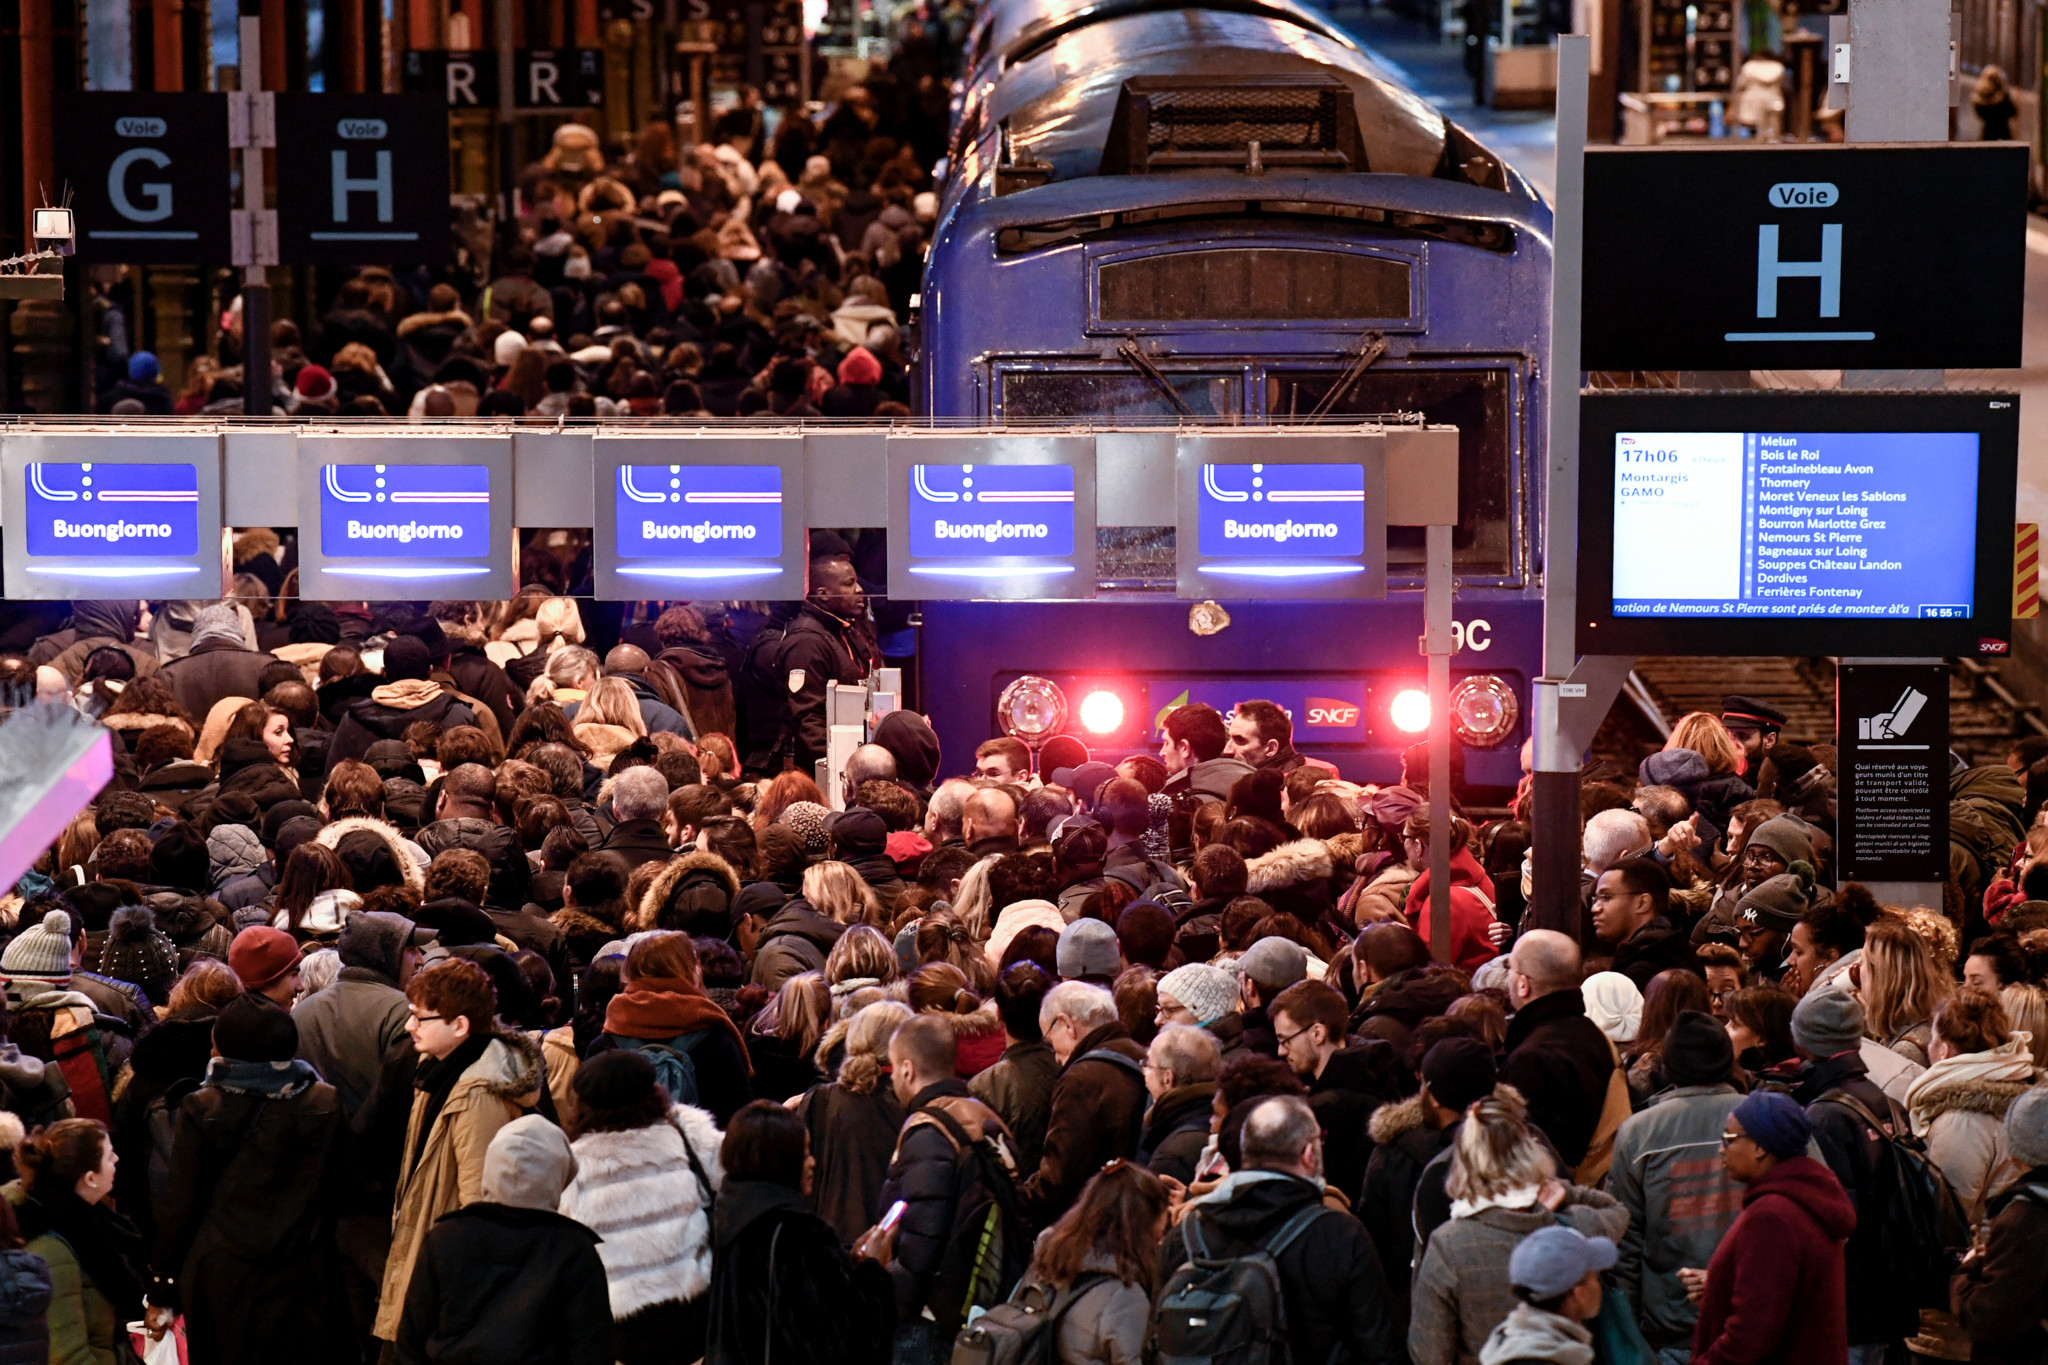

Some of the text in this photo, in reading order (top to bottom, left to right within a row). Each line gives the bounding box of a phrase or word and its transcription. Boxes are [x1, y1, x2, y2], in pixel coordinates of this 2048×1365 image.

[446, 62, 480, 105] R
[529, 62, 563, 104] R
[122, 120, 160, 135] Voie
[344, 121, 380, 136] Voie
[108, 148, 173, 222] G
[332, 150, 393, 222] H
[1778, 187, 1829, 205] Voie
[1756, 223, 1842, 318] H
[1760, 436, 1797, 447] Melun
[1622, 449, 1678, 463] 17h06
[1760, 450, 1820, 460] Bois le Roi
[1760, 464, 1873, 474] Fontainebleau Avon
[1621, 472, 1689, 485] Montargis
[1760, 477, 1810, 490] Thomery
[1620, 487, 1664, 497] GAMO
[1759, 491, 1907, 502] Moret Veneux les Sablons
[1759, 505, 1868, 517] Montigny sur Loing
[1224, 519, 1338, 542] Buongiorno
[1758, 519, 1886, 529] Bourron Marlotte Grez
[54, 520, 172, 543] Buongiorno
[348, 521, 464, 543] Buongiorno
[643, 521, 757, 543] Buongiorno
[934, 520, 1049, 543] Buongiorno
[1758, 532, 1862, 542] Nemours St Pierre
[1758, 546, 1867, 558] Bagneaux sur Loing
[1757, 559, 1902, 571] Souppes Château Landon
[1757, 573, 1807, 583] Dordives
[1757, 586, 1863, 599] Ferrières Fontenay
[1614, 603, 1650, 613] nation
[1652, 603, 1666, 613] de
[1669, 603, 1719, 613] Nemours
[1722, 603, 1734, 613] St
[1736, 603, 1769, 613] Pierre
[1771, 605, 1796, 613] sont
[1798, 604, 1826, 616] priés
[1828, 604, 1841, 614] de
[1844, 605, 1885, 614] monter
[1925, 608, 1938, 617] 16
[1939, 608, 1953, 617] 55
[1980, 643, 2006, 651] SNCF
[1307, 708, 1358, 724] SNCF
[1742, 908, 1758, 924] NY
